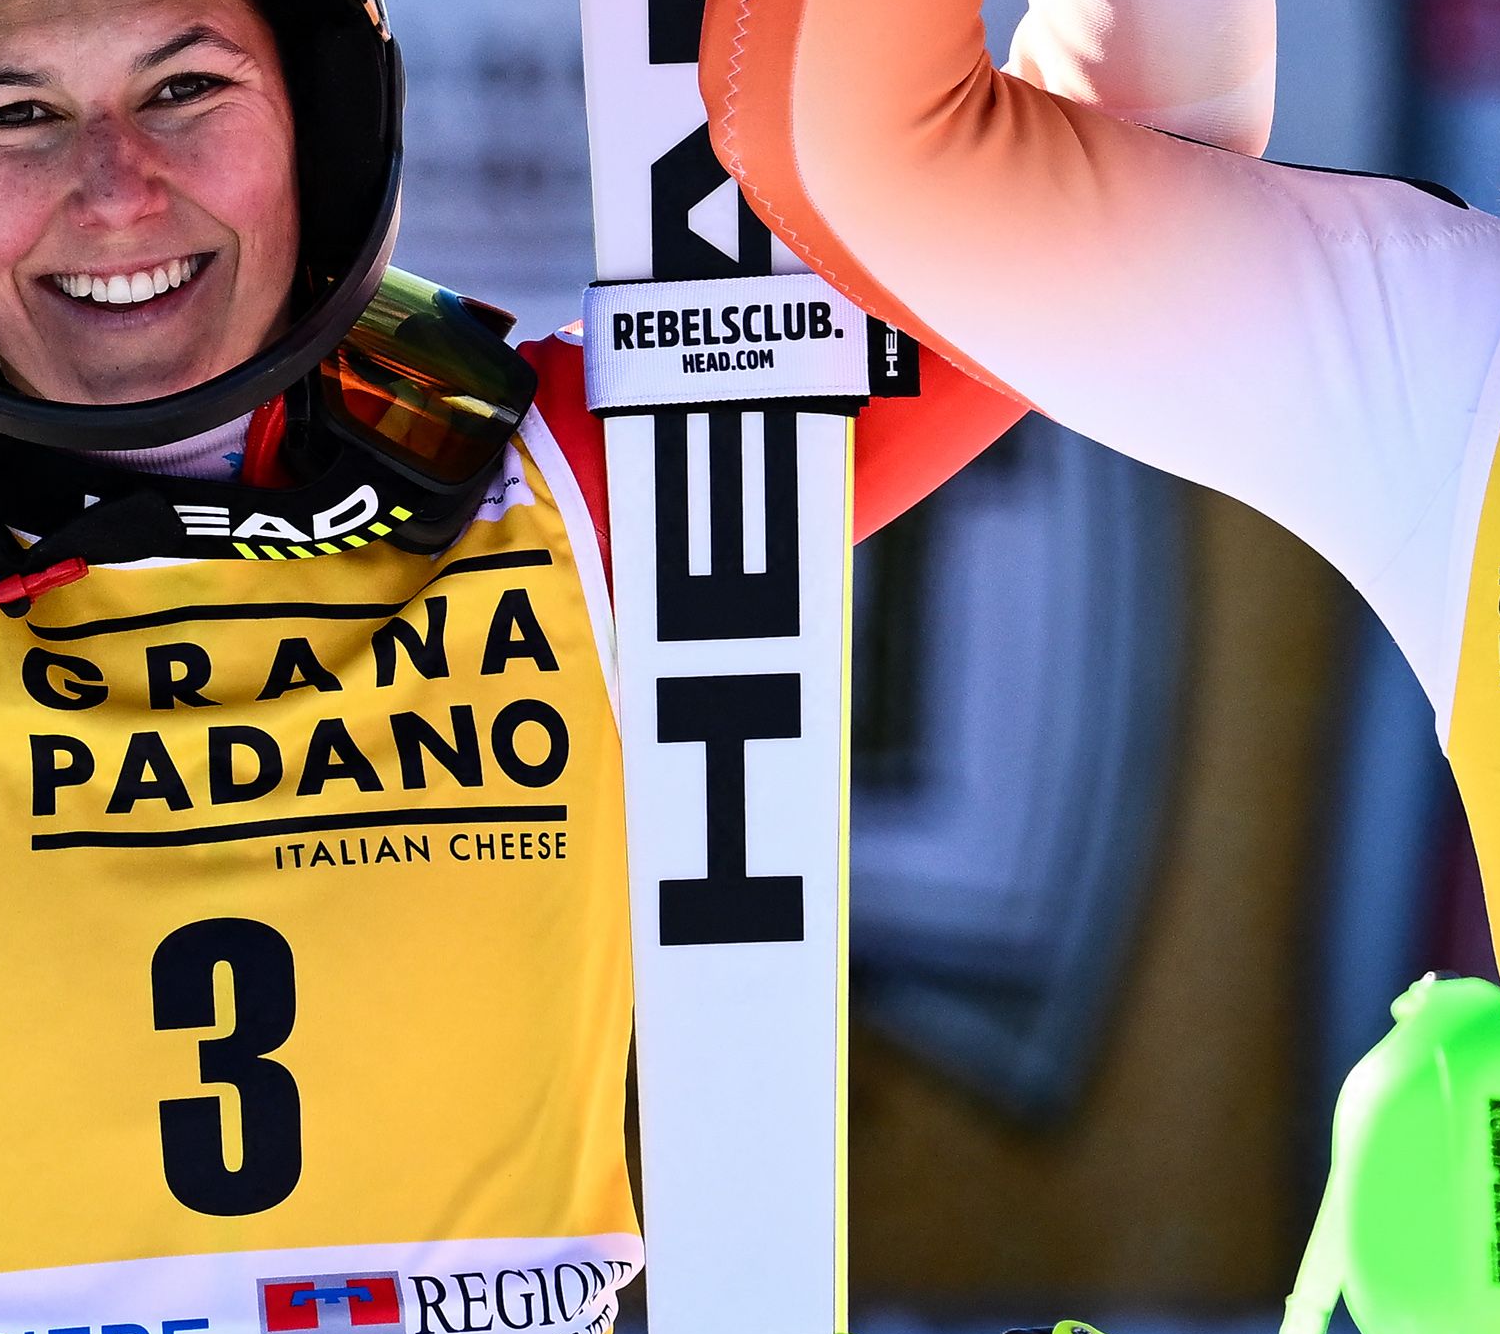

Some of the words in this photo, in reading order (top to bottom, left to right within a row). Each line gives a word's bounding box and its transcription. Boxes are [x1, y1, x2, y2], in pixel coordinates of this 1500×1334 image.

[612, 300, 845, 351] REBELSCLUB.
[682, 348, 774, 374] HEAD.COM
[84, 484, 379, 540] EAD
[22, 588, 560, 711] GRANA
[28, 698, 570, 816] PADANO
[274, 835, 432, 871] ITALIAN
[450, 832, 568, 862] CHEESE
[151, 917, 302, 1217] 3
